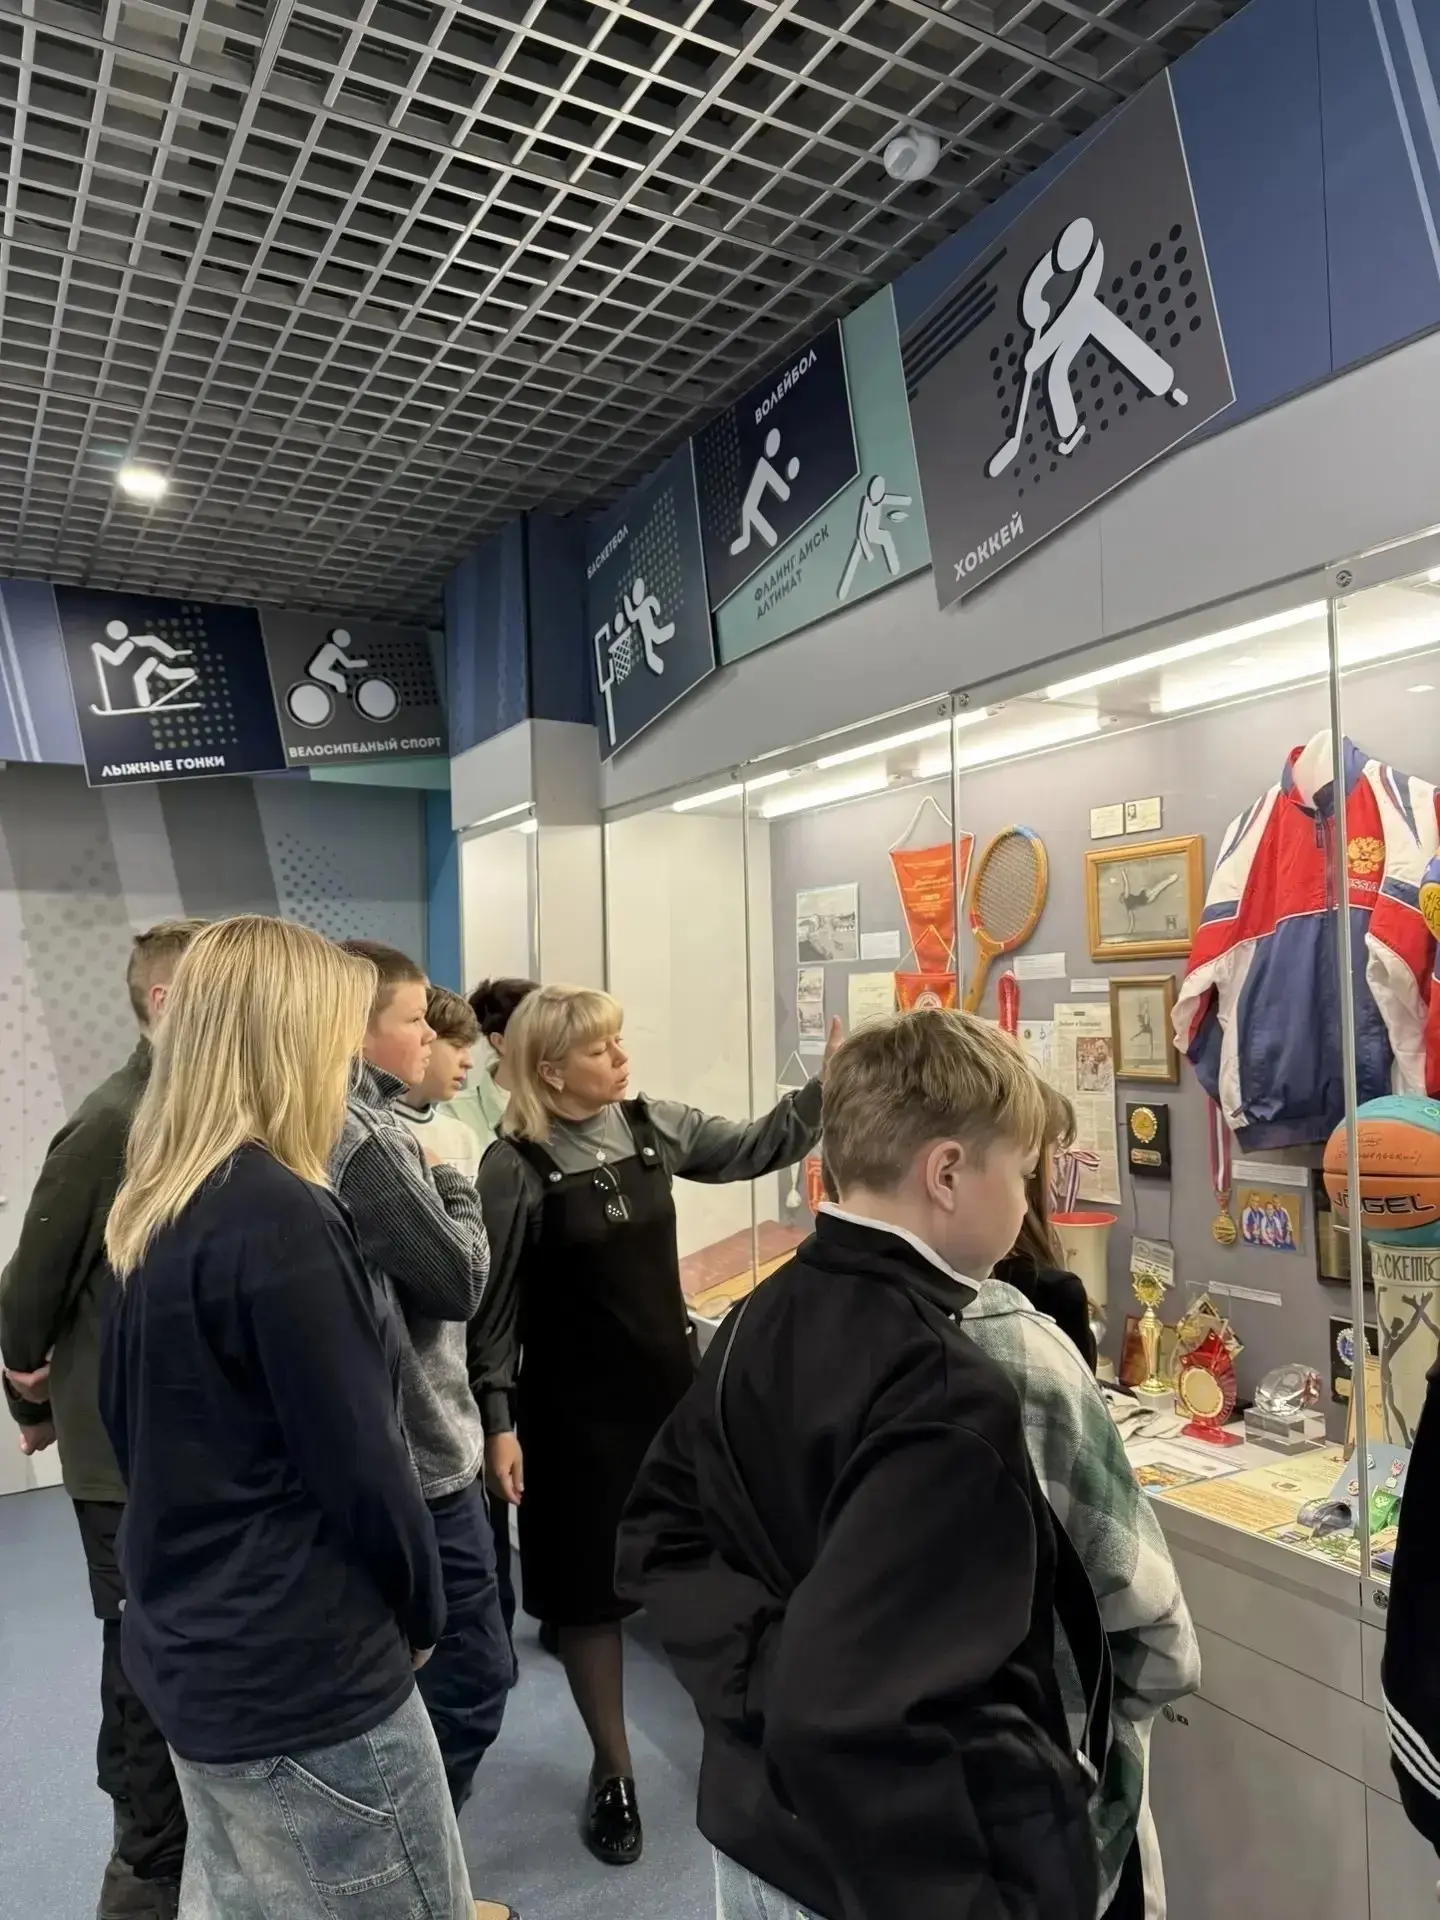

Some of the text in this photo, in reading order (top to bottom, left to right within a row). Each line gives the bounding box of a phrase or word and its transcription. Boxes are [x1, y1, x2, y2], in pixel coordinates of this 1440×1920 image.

[755, 348, 818, 425] ВОЛЕЙБОЛ
[586, 523, 629, 580] БАСКЕТБОЛ
[798, 523, 830, 565] ДИСК
[953, 511, 1024, 583] ХОККЕЙ
[756, 567, 803, 621] АЛТИМАТ
[101, 755, 226, 778] ЛЫЖНЫЕ ГОНКИ
[288, 736, 442, 759] ВЕЛОСИПЕДНЫЙ СПОРТ
[1334, 1188, 1437, 1215] JGEL
